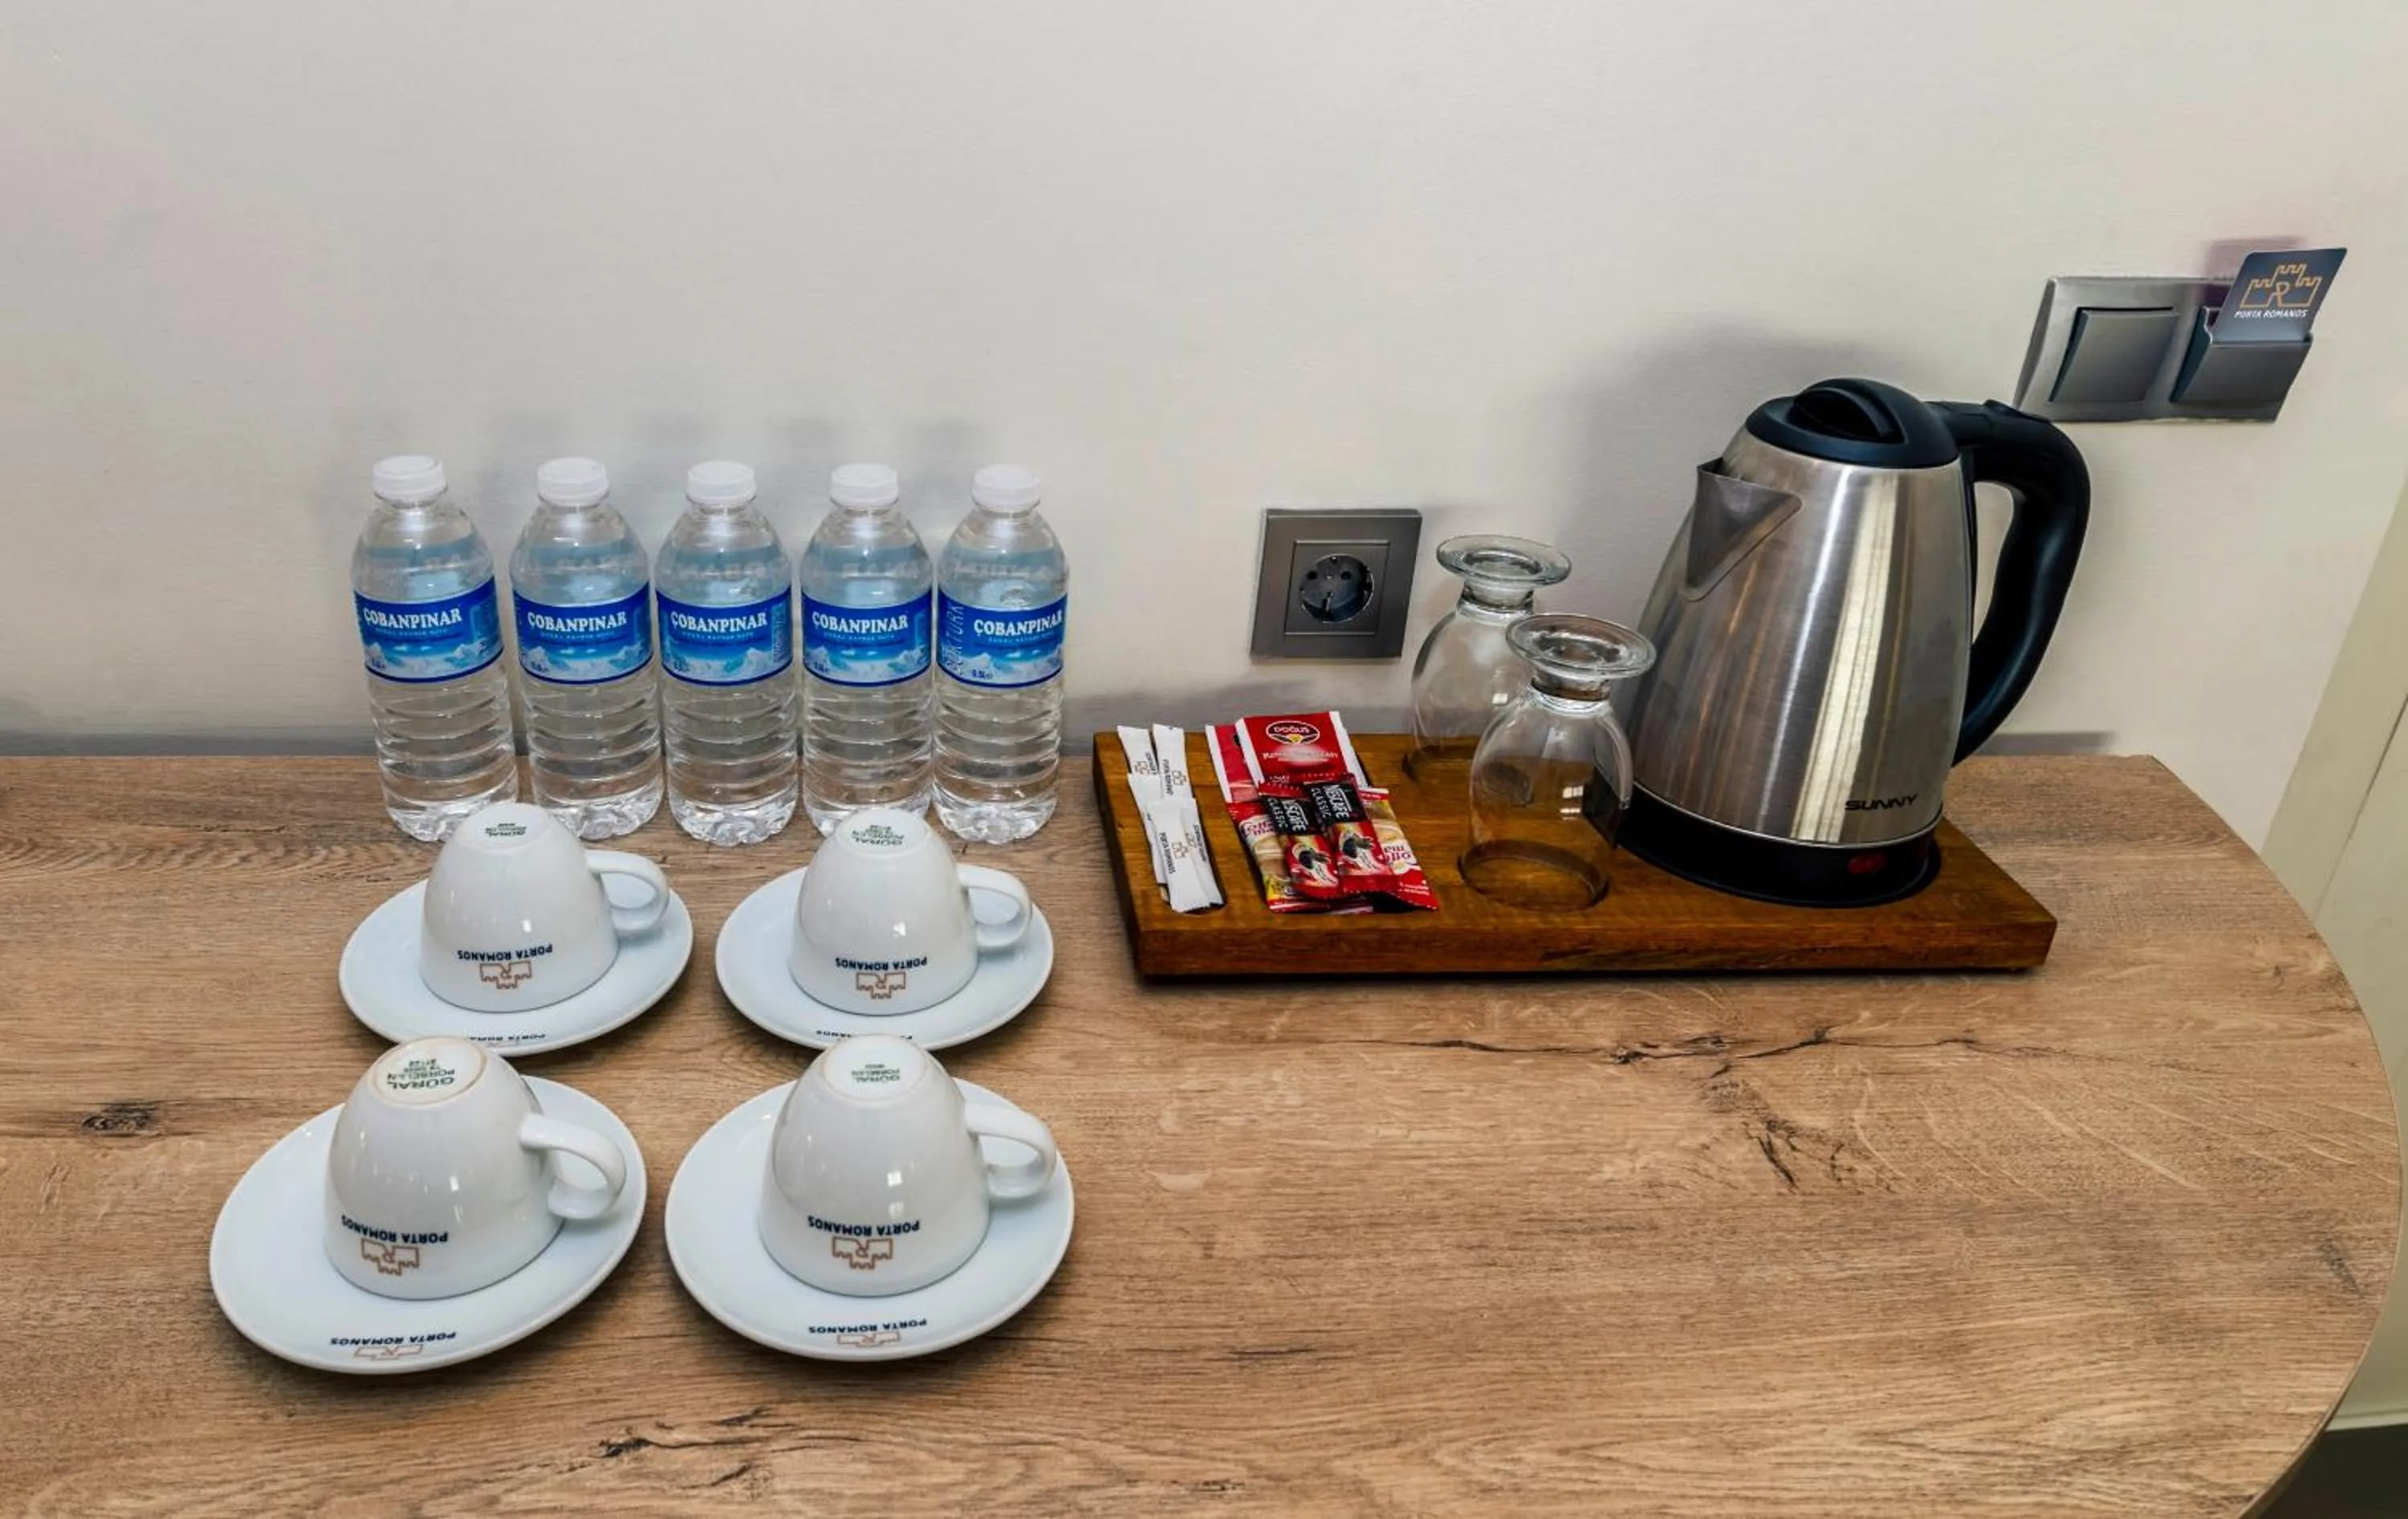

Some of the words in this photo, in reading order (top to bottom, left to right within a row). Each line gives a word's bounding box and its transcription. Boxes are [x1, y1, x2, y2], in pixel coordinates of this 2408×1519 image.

[2264, 308, 2308, 319] ROMANOS
[1311, 787, 1332, 818] CLASSIC
[1845, 794, 1918, 811] SUNNY
[457, 951, 511, 961] ROMANOS
[515, 943, 553, 960] PORTA
[835, 958, 889, 971] ROMANOS
[893, 955, 927, 970] PORTA
[341, 1215, 397, 1242] ROMANOS
[807, 1215, 872, 1236] ROMANOS
[877, 1220, 920, 1236] PORTA
[401, 1231, 449, 1244] PORTA
[808, 1324, 877, 1334] ROMANOS
[883, 1317, 927, 1330] PORTA
[330, 1336, 404, 1346] ROMANOS
[409, 1331, 457, 1344] PORTA
